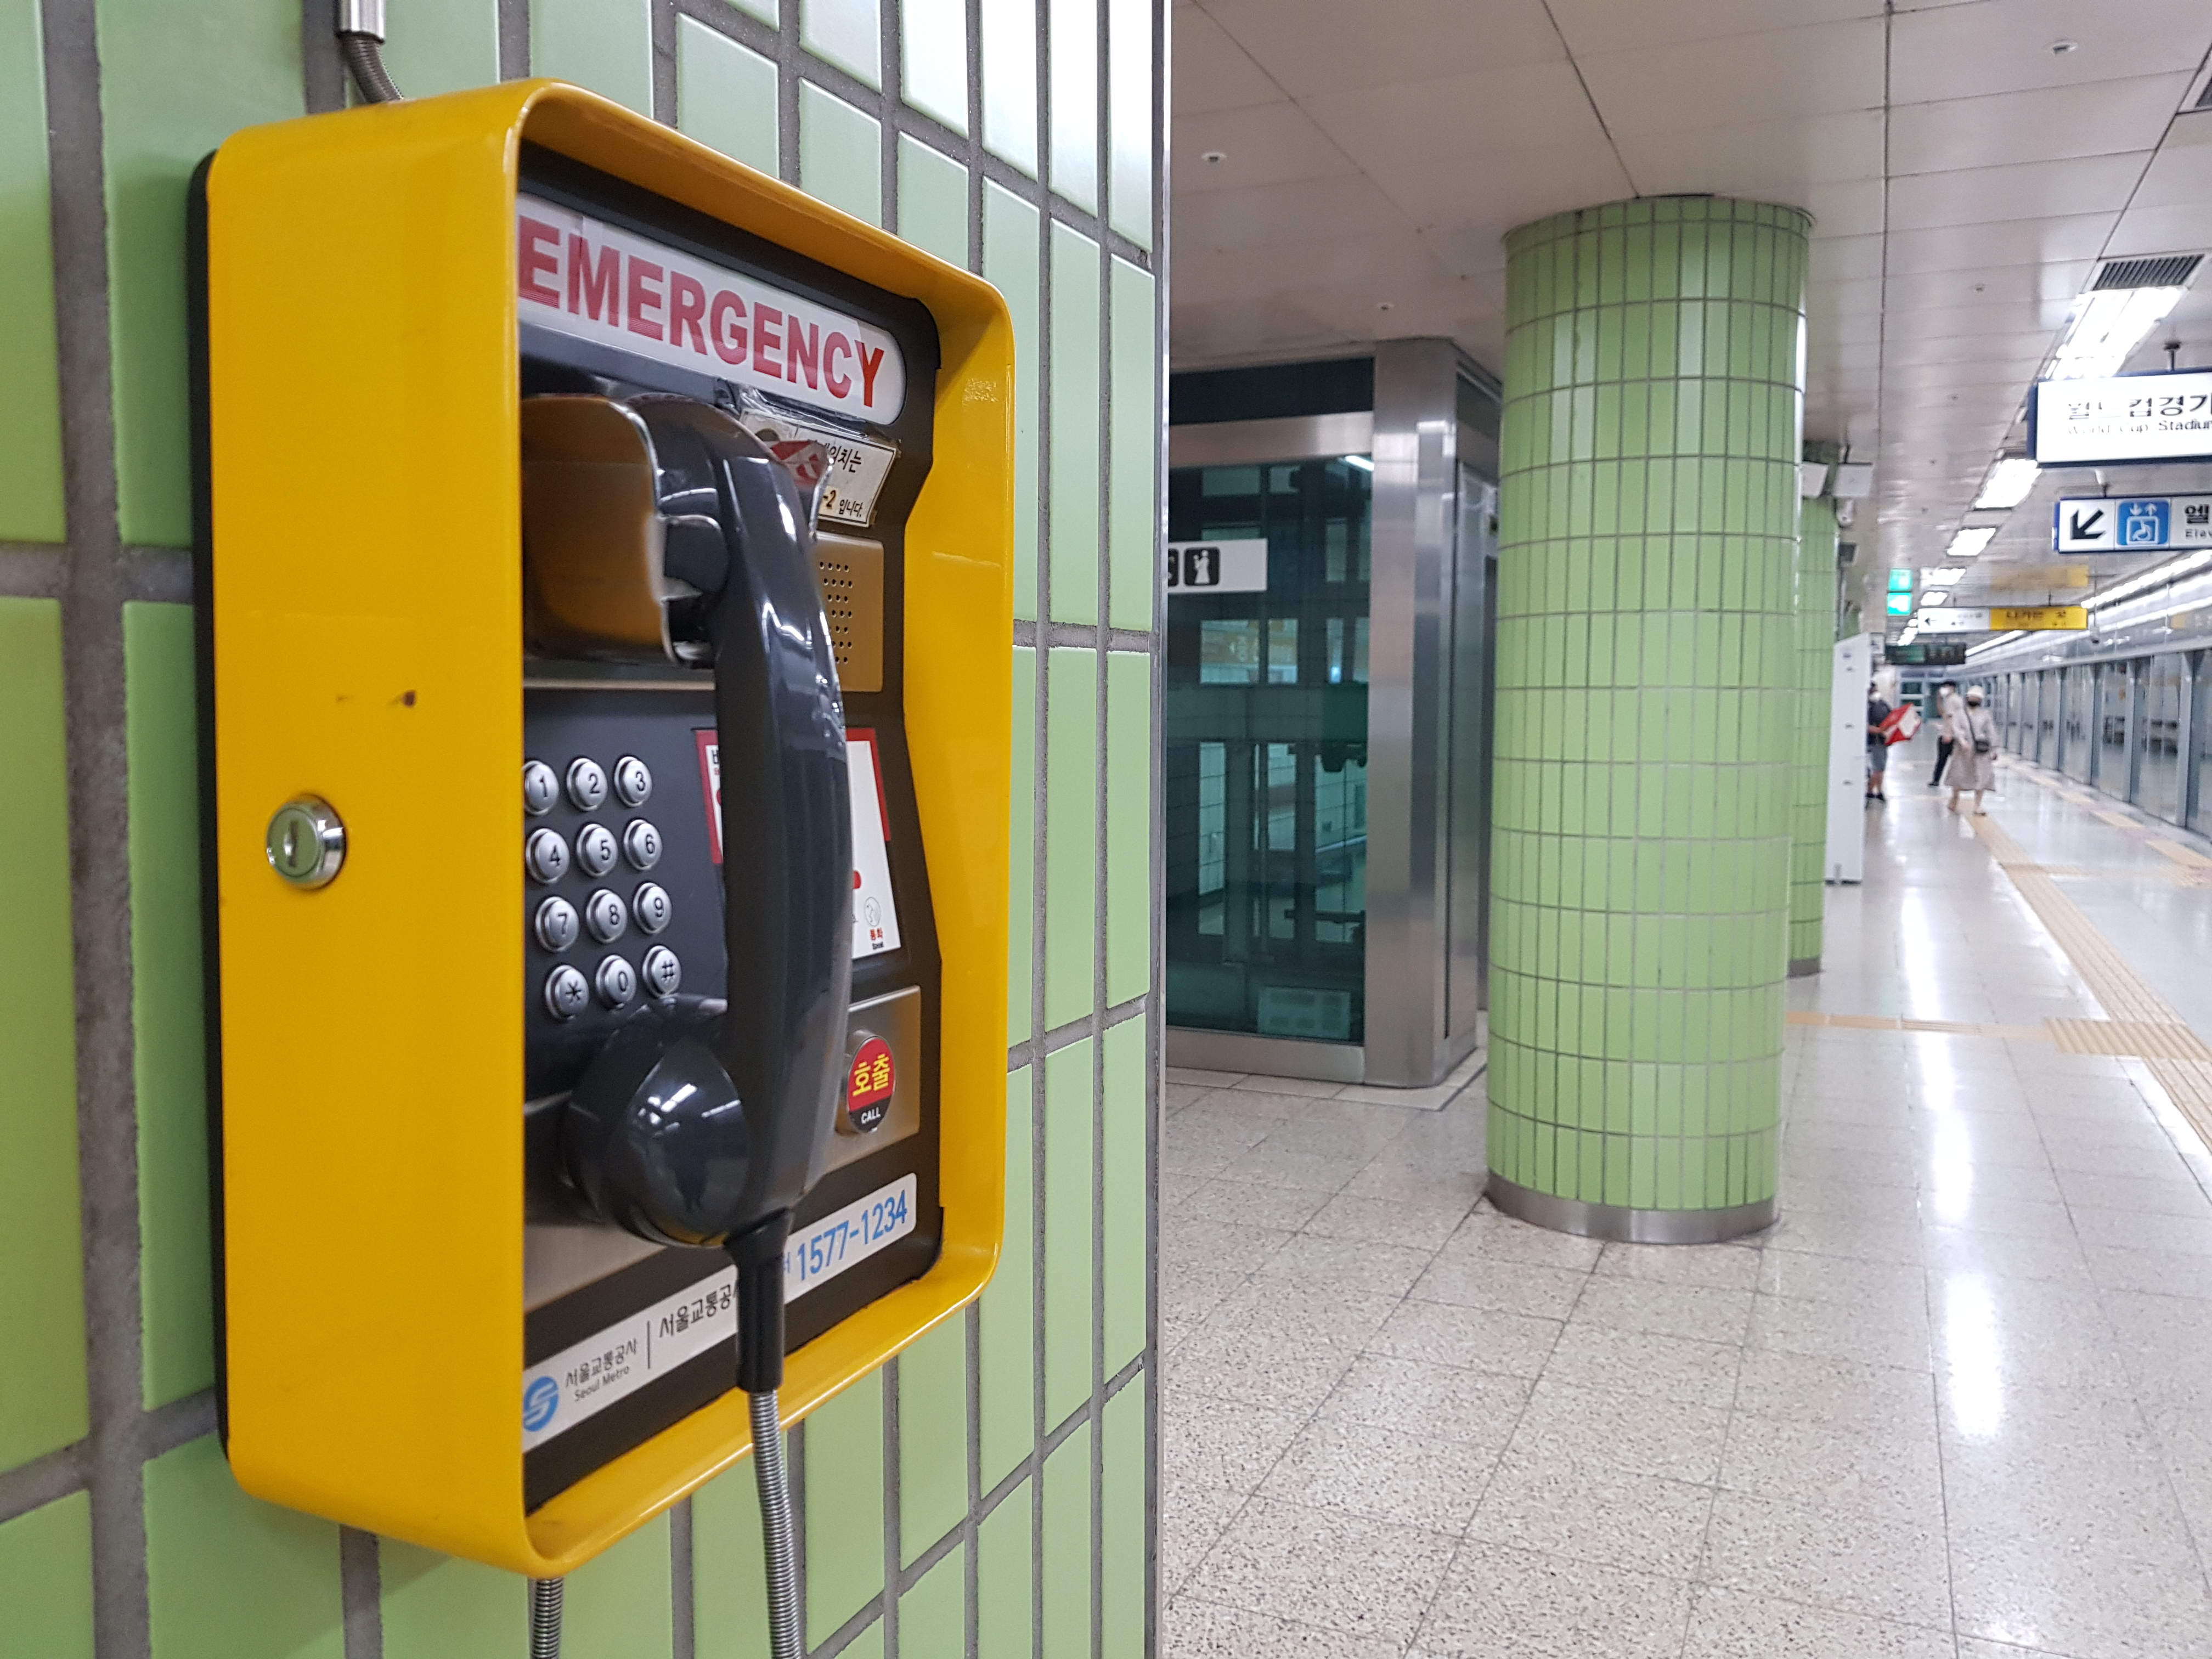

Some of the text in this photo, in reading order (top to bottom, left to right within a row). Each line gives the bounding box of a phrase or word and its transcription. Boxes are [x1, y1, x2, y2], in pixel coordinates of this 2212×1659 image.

[519, 215, 884, 407] EMERGENCY
[825, 443, 861, 473] 위치는
[839, 499, 863, 517] 입니다.
[540, 771, 645, 798] 1 2 3
[549, 833, 656, 867] 4 5 6
[558, 897, 664, 935] 7 8 9
[618, 970, 628, 995] 0
[853, 1053, 890, 1097] 호출
[861, 1107, 881, 1124] CALL
[797, 1189, 907, 1281] 1577-1234
[566, 1338, 637, 1387] 서울교통공사
[574, 1366, 629, 1402] Seoul Metro
